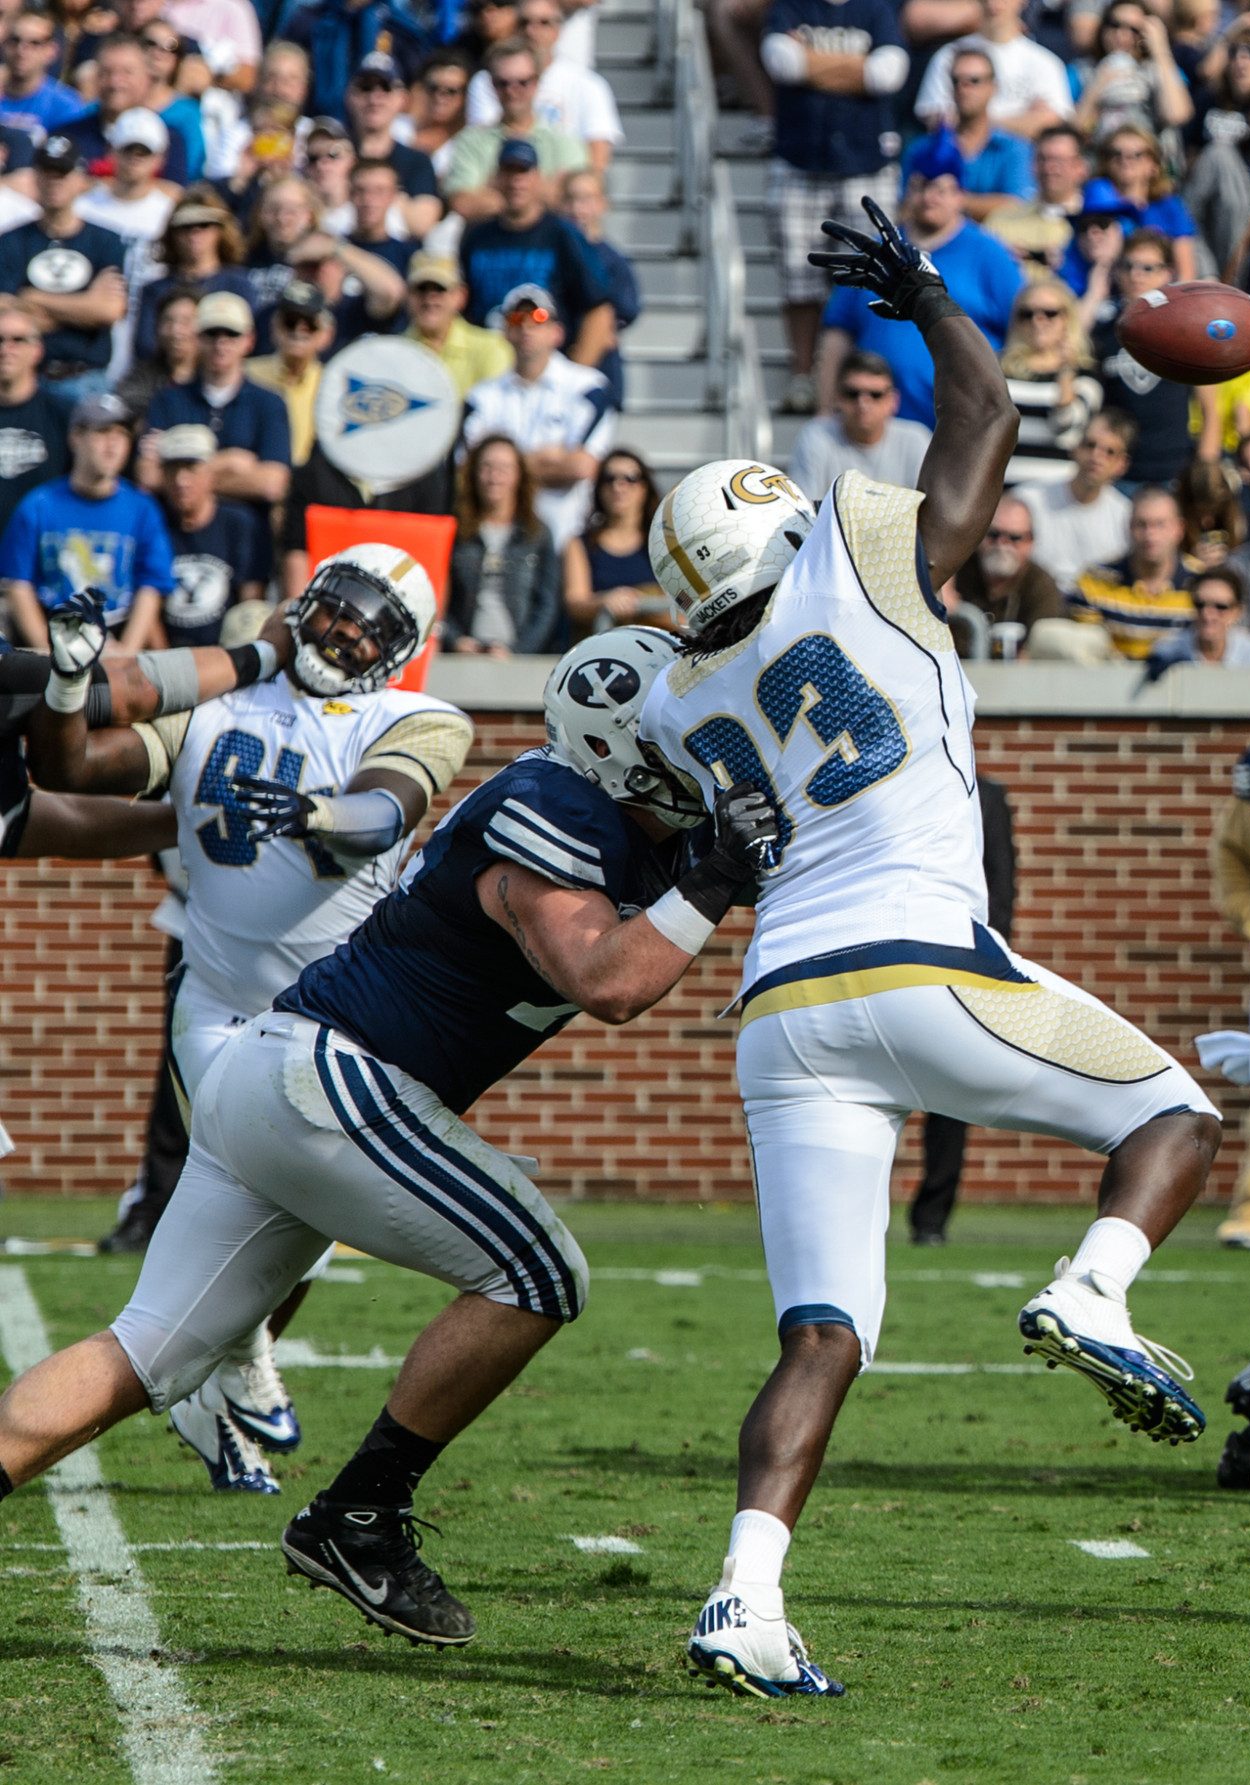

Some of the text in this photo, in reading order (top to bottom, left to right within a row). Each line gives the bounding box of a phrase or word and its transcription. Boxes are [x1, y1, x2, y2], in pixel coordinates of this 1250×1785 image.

[696, 545, 711, 561] 93
[696, 587, 738, 624] JACKETS
[577, 662, 629, 704] Y
[692, 1597, 747, 1637] NIKE
